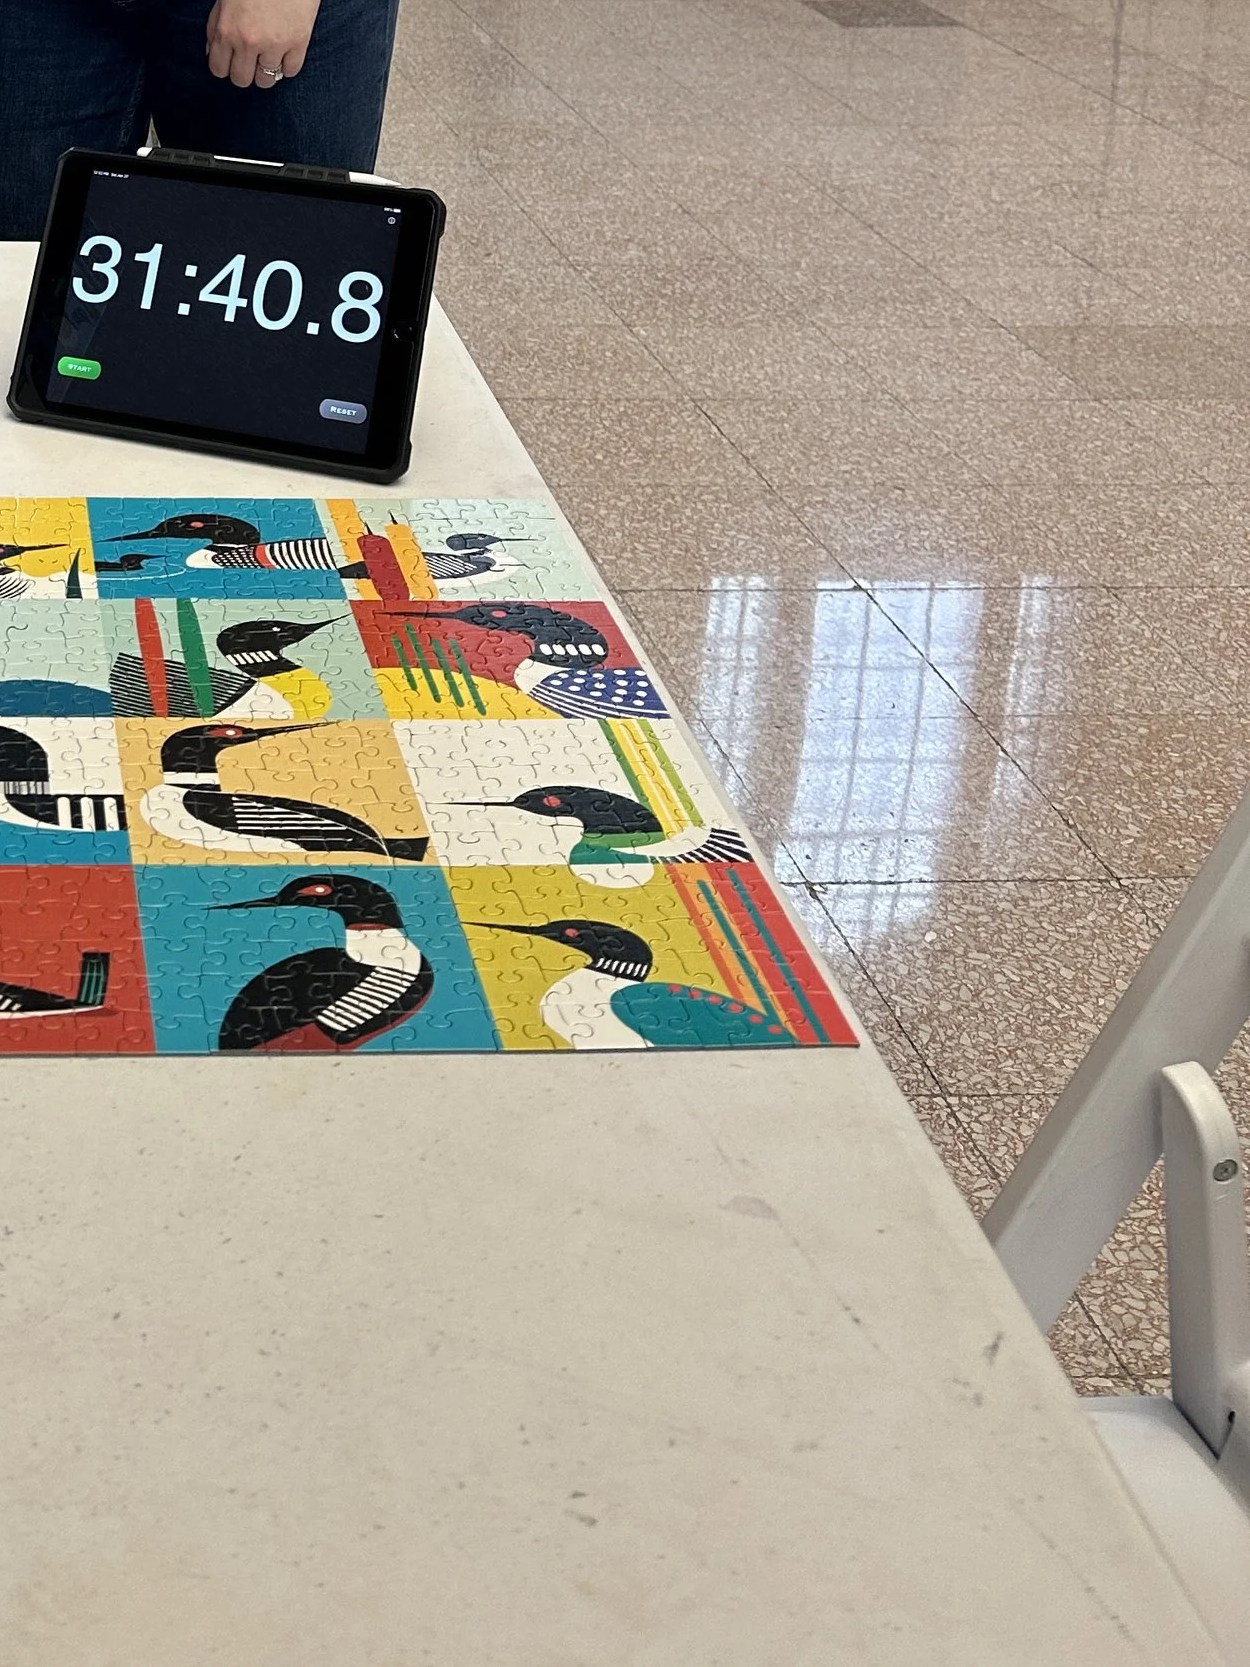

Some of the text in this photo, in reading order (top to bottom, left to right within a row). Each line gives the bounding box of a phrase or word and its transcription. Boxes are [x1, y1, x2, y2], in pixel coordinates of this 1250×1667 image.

[71, 234, 385, 343] 31:40.8
[67, 363, 92, 373] START
[330, 405, 358, 416] RESET
